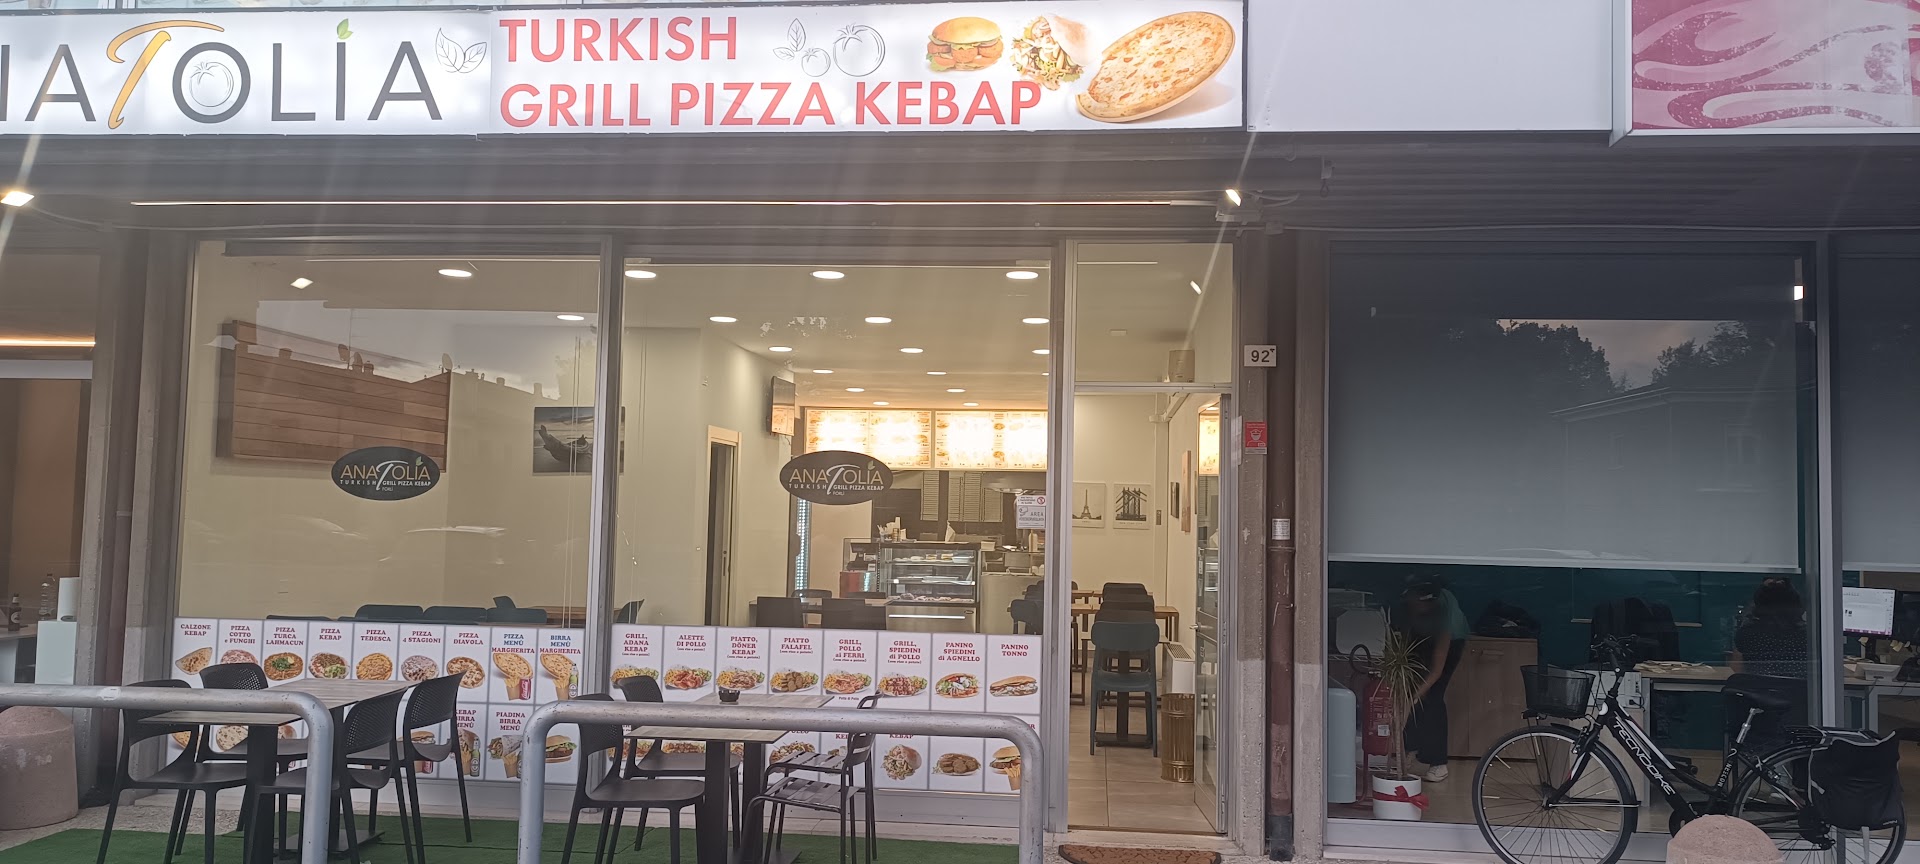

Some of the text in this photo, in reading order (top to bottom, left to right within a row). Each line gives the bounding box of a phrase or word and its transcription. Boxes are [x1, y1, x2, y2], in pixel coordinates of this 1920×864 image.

[500, 16, 738, 63] TURKISH
[0, 18, 442, 130] ATOLIA
[500, 81, 1041, 128] GRILL PIZZA KEBAP
[340, 458, 430, 491] ANATOLIA
[789, 462, 883, 495] ANATOLIA
